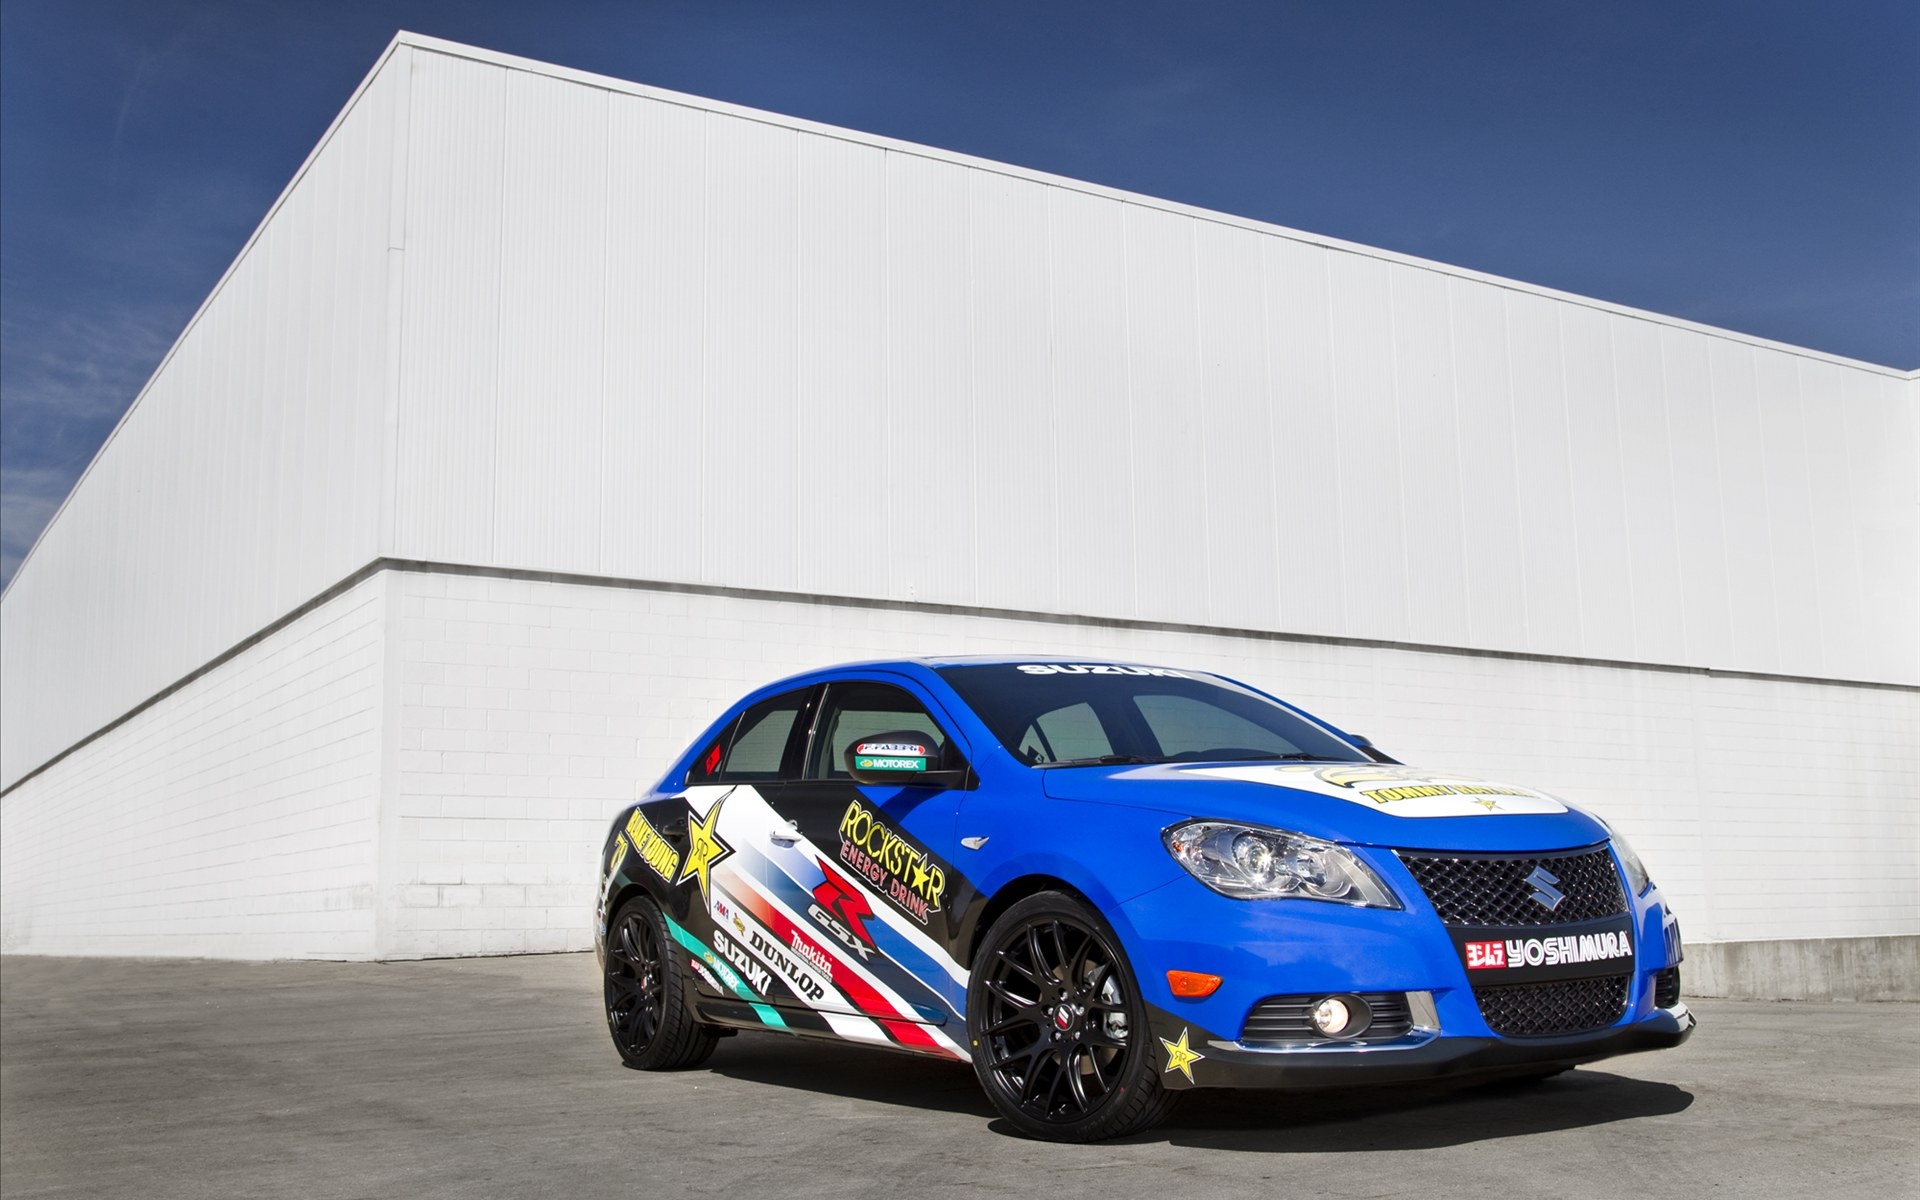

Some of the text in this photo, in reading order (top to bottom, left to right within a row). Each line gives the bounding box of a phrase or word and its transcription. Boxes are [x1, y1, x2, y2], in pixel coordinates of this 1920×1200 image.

[873, 758, 919, 769] MOTOREX
[1359, 784, 1457, 804] TOMMY
[641, 829, 679, 882] YOUNG
[841, 839, 929, 921] ENERGY DRINK
[807, 903, 876, 962] GSX
[1505, 930, 1633, 968] YOSHIMURA
[713, 929, 773, 997] SUZUKI
[749, 930, 825, 1001] DUNLOP
